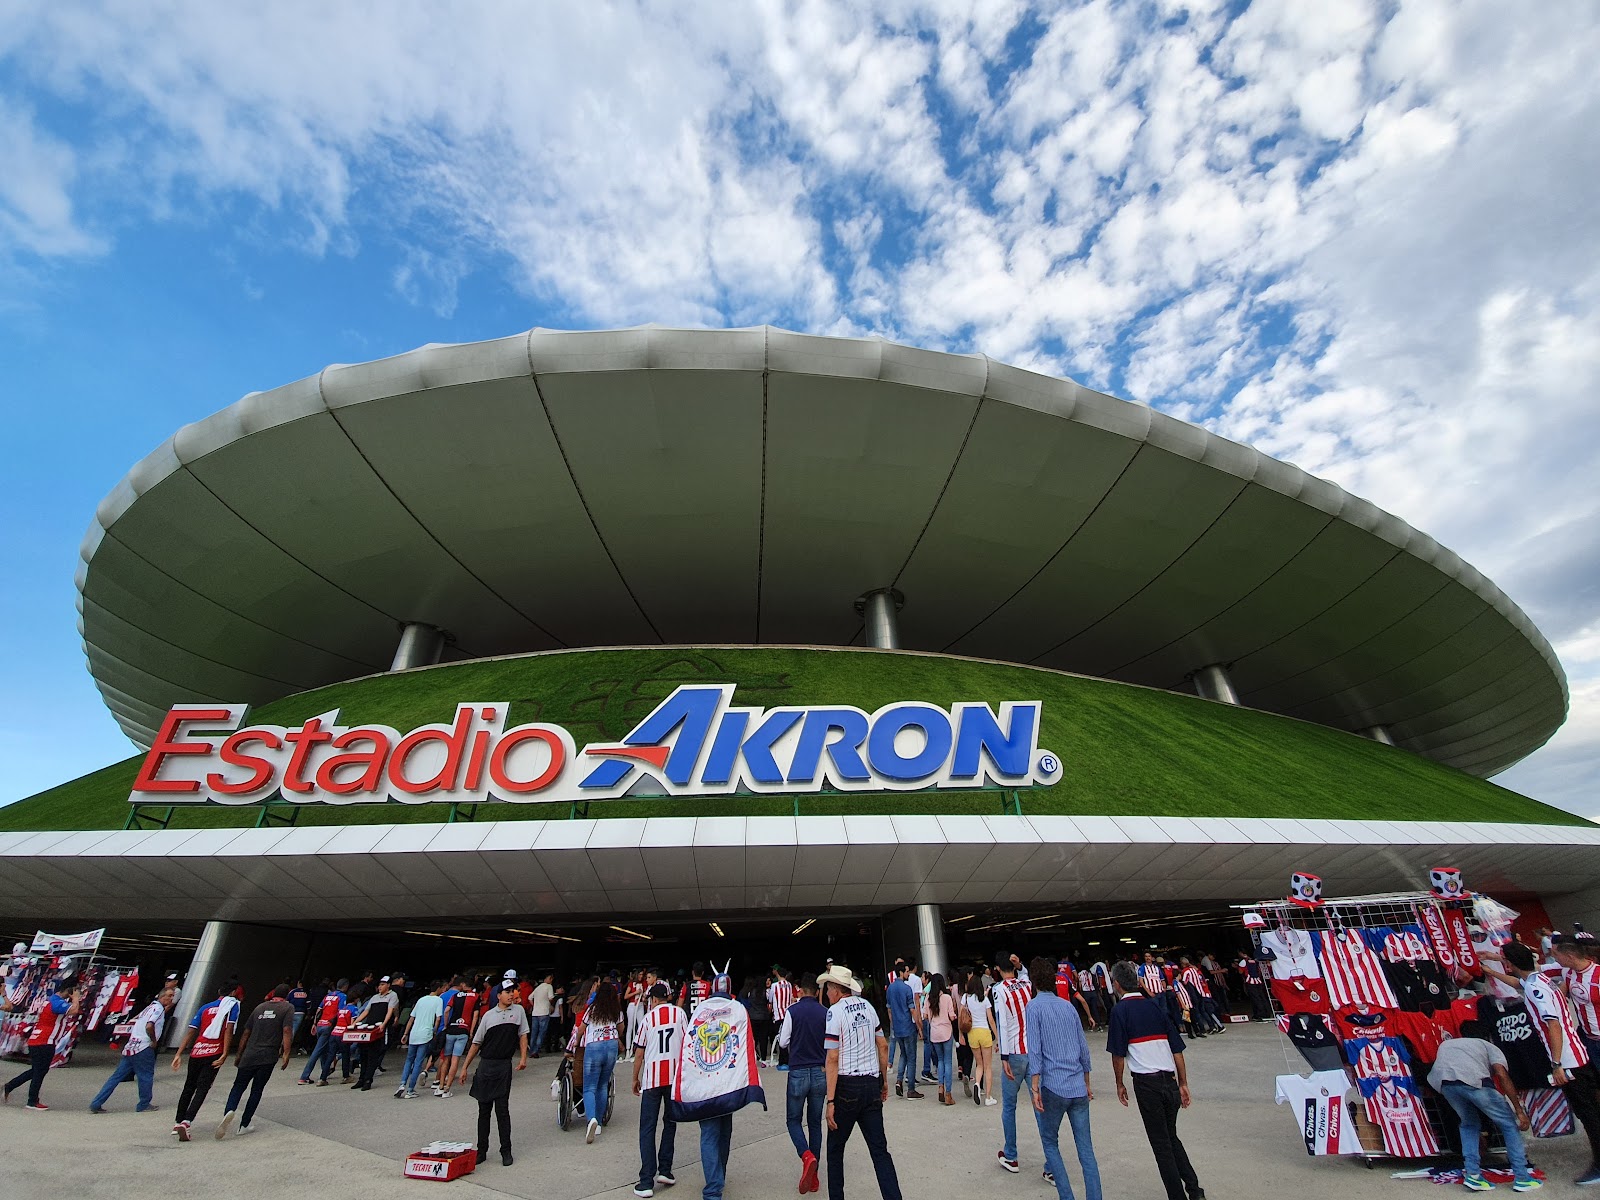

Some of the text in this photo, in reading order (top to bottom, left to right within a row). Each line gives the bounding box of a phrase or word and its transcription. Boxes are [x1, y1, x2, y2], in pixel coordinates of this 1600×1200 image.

[133, 707, 566, 794] Estadio
[578, 688, 1037, 788] AKRON
[845, 1002, 867, 1013] TECATE
[657, 1028, 675, 1054] 17
[1499, 1024, 1532, 1042] TODOS
[412, 1163, 433, 1173] TECATE
